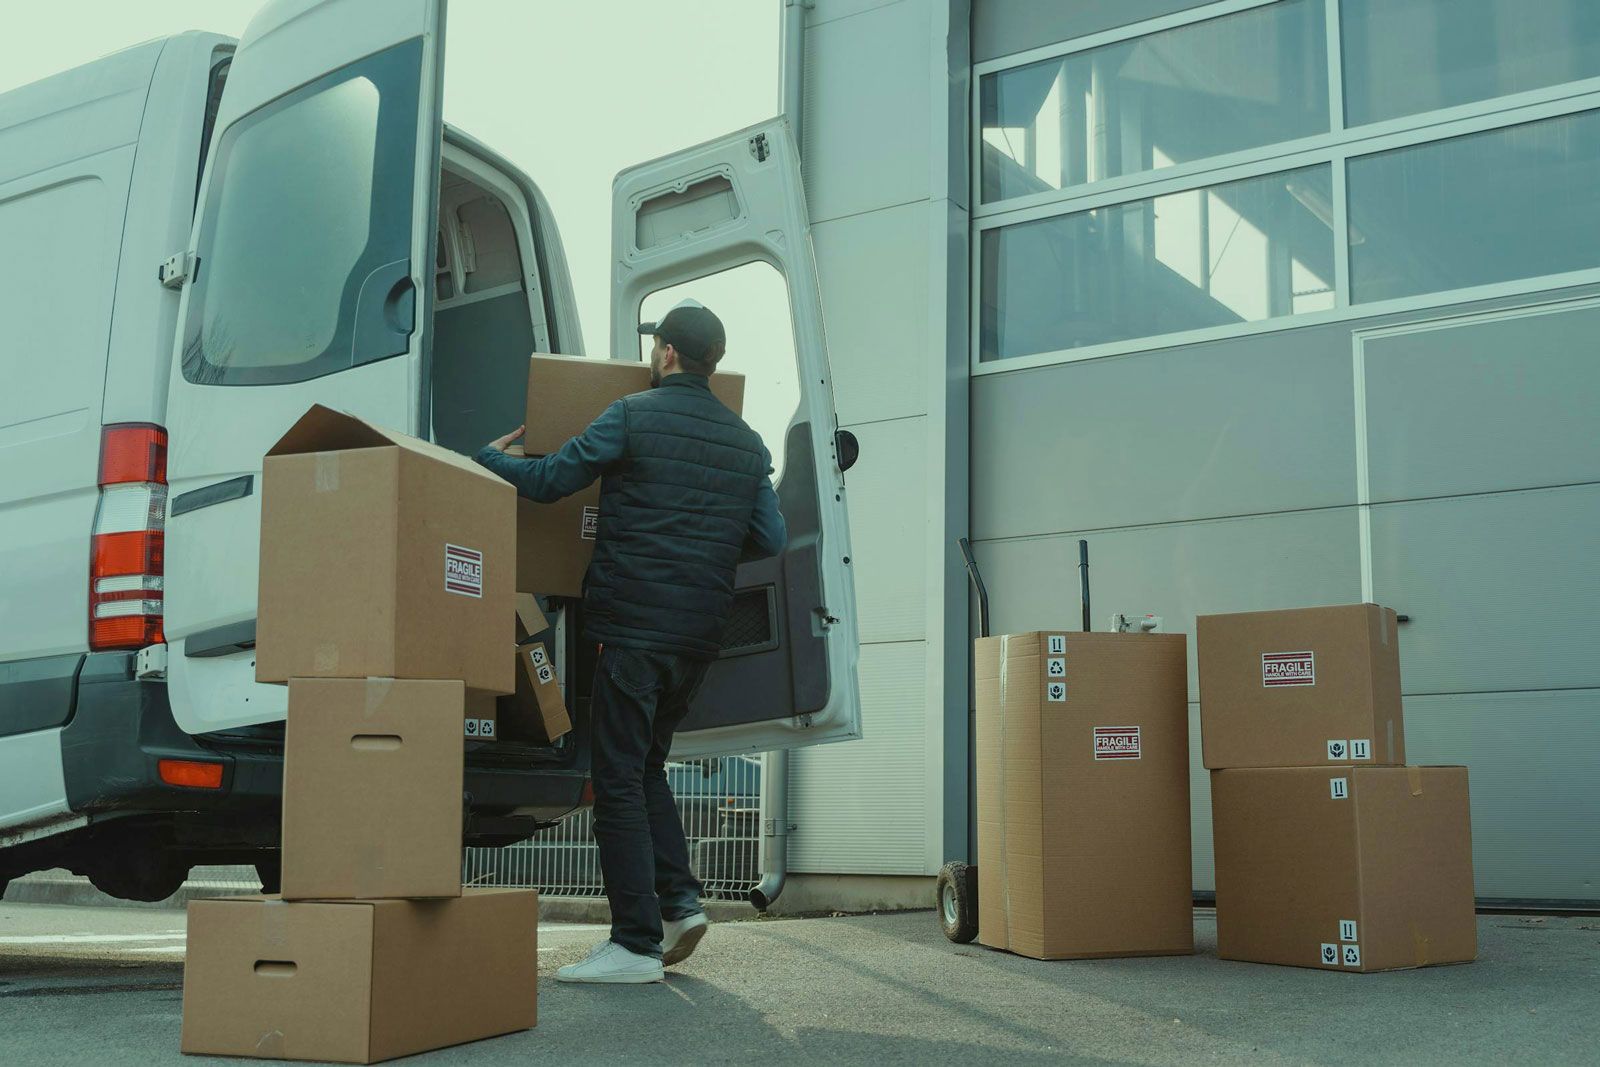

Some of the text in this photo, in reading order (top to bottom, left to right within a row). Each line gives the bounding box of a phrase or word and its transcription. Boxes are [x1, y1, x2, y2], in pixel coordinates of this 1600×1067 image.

[447, 559, 480, 578] FRAGILE
[1264, 662, 1312, 673] FRAGILE
[1096, 736, 1138, 746] FRAGILE
